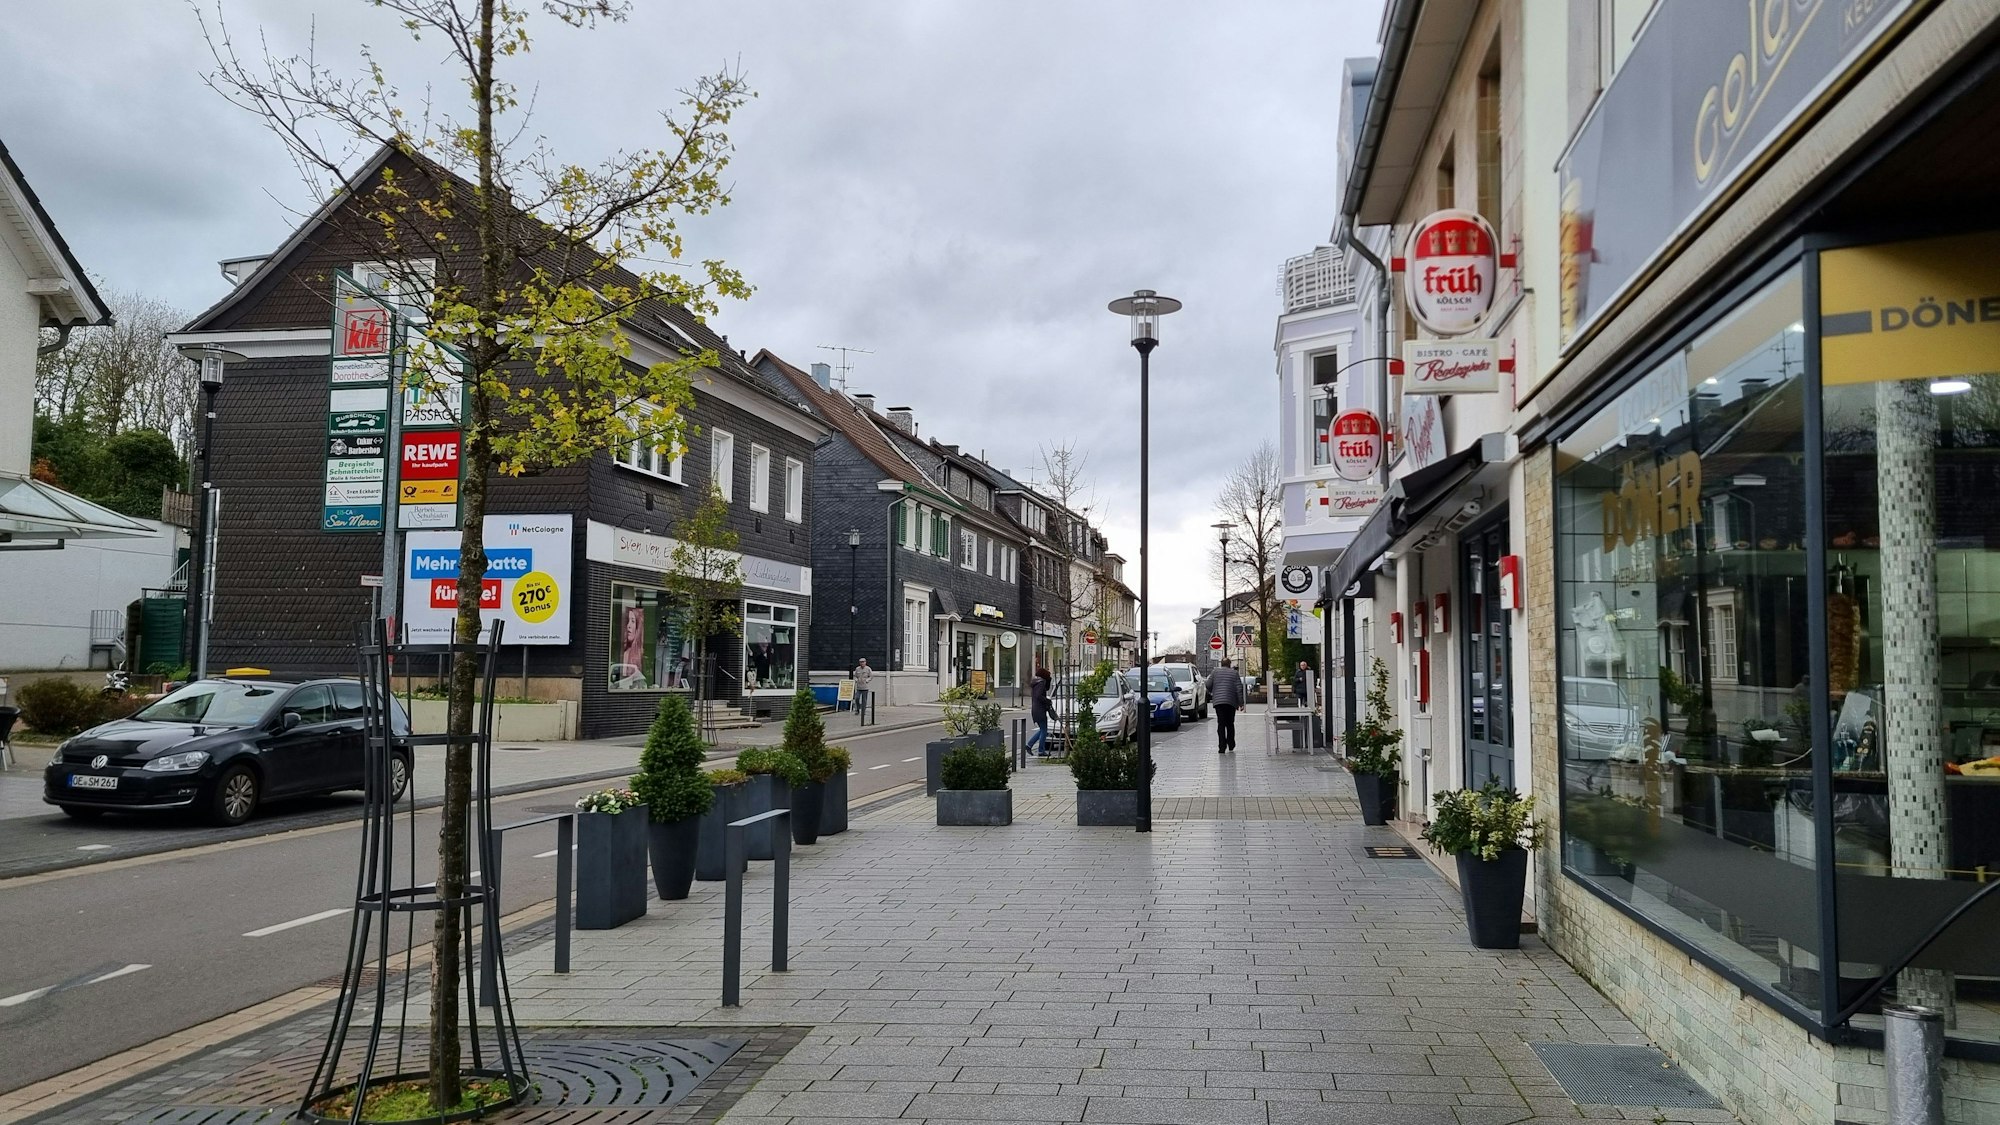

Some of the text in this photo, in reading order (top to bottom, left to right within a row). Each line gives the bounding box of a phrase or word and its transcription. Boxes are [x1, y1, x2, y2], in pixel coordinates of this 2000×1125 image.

[1423, 264, 1482, 295] früh
[1437, 296, 1472, 304] KÖLSCH
[1462, 348, 1488, 357] CAFÉ
[348, 446, 380, 455] Barbershop
[404, 443, 457, 461] REWE
[1339, 440, 1373, 457] früh
[1603, 450, 1702, 554] DÖNER
[522, 526, 564, 536] NetCologne
[416, 556, 527, 571] Mehr atte
[435, 585, 458, 601] für
[524, 603, 551, 613] Bonus
[101, 778, 116, 788] 261
